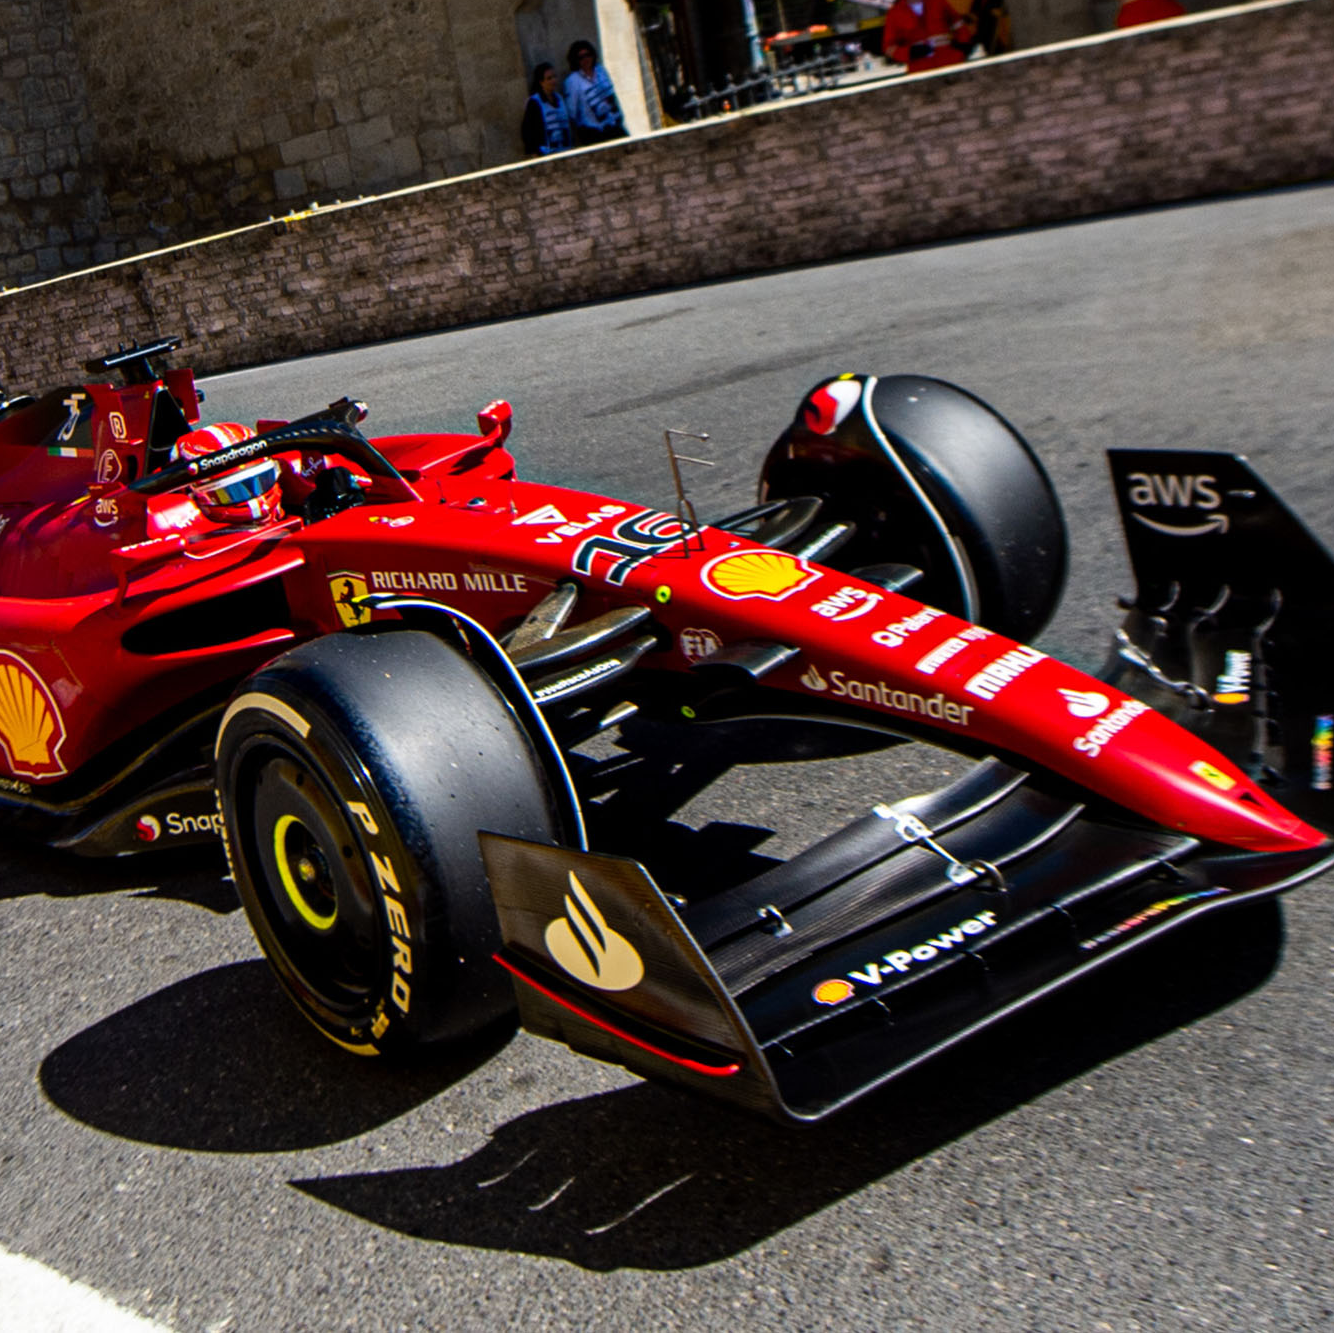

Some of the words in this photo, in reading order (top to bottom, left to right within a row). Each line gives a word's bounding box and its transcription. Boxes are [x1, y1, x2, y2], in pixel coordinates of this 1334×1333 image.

[200, 439, 268, 472] Snapdragon
[95, 498, 119, 515] aws
[1127, 472, 1222, 510] aws
[572, 508, 711, 587] 16
[371, 571, 458, 591] RICHARD
[462, 573, 528, 593] MILLE
[809, 586, 868, 618] aws
[829, 670, 975, 726] Santander
[346, 800, 380, 836] P
[369, 851, 413, 1014] ZERO
[846, 909, 998, 986] V-Power
